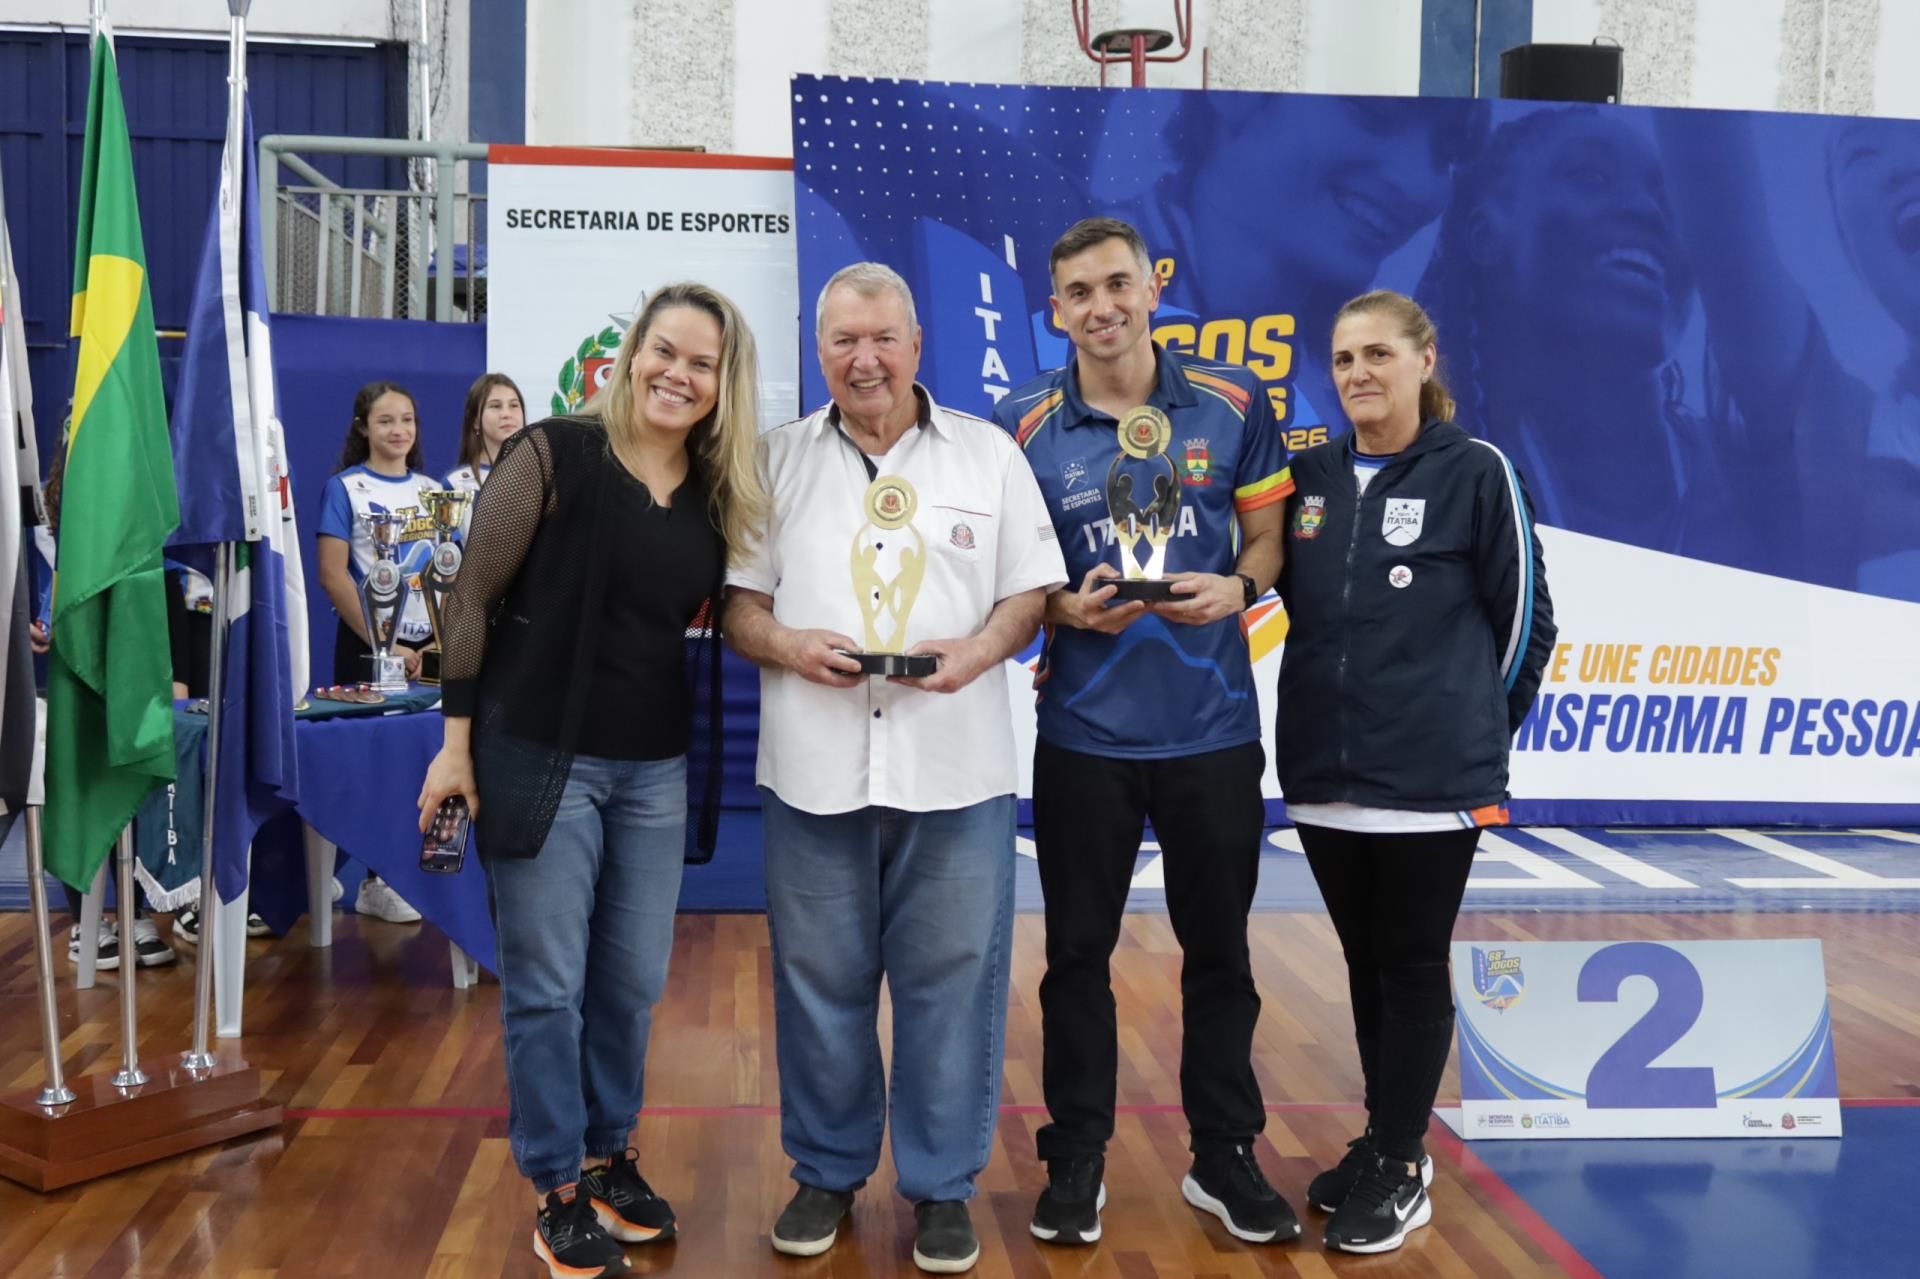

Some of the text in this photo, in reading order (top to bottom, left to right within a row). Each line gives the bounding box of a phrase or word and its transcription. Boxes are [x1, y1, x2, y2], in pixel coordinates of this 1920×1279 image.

[506, 208, 790, 234] SECRETARIA DE ESPORTES
[1062, 487, 1101, 504] SECRETARIA
[1063, 494, 1103, 512] DE ESPORTES
[1386, 516, 1419, 526] ITATIBA
[1579, 643, 1643, 684] UNE
[1648, 645, 1781, 686] CIDADES
[1510, 693, 1748, 755] NSFORMA
[1489, 958, 1520, 971] JOGOS
[1577, 941, 1717, 1109] 2
[1534, 1114, 1570, 1126] ITATIBA
